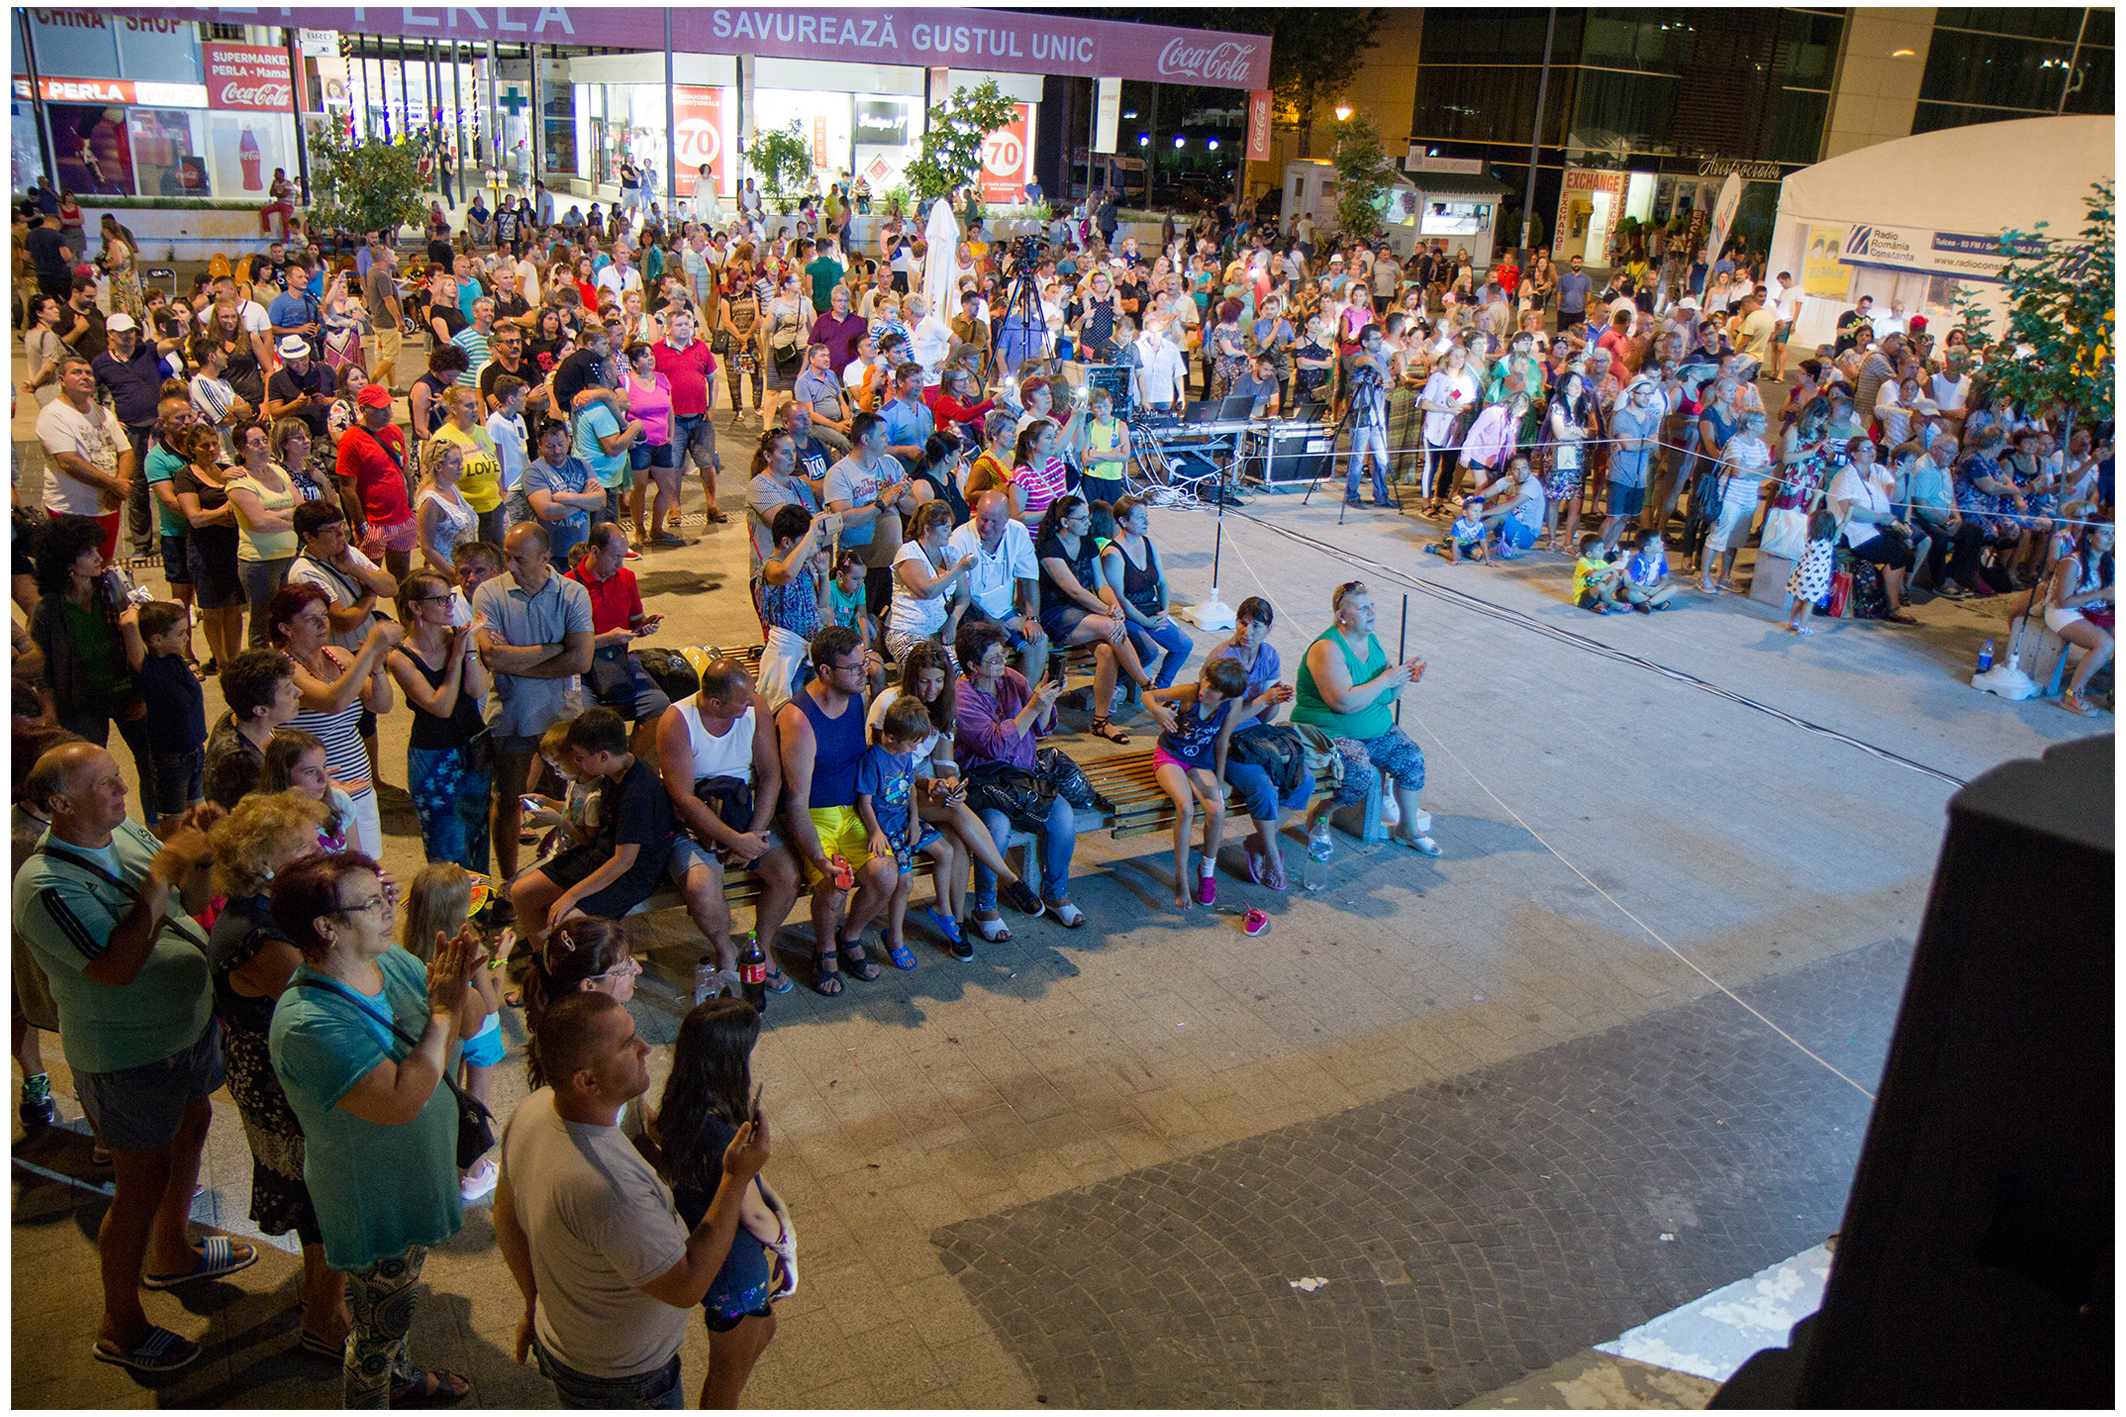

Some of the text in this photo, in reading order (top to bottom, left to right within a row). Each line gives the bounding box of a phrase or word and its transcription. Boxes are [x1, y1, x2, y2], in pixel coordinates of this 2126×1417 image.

[35, 9, 106, 29] CHINA
[307, 31, 332, 41] BRD
[712, 9, 1094, 62] SAVUREAZĂ GUSTUL UNIC
[1157, 37, 1257, 81] Coca-Cola
[212, 65, 248, 78] PERLA
[48, 81, 126, 101] PERLA
[220, 81, 291, 106] Coca-Cola
[1566, 172, 1620, 192] EXCHANGE
[1555, 191, 1569, 251] EXCHANGE
[1604, 193, 1619, 261] EXCHANGE
[1874, 229, 1898, 240] Radio
[1871, 239, 1909, 251] România
[466, 461, 500, 477] LOVE
